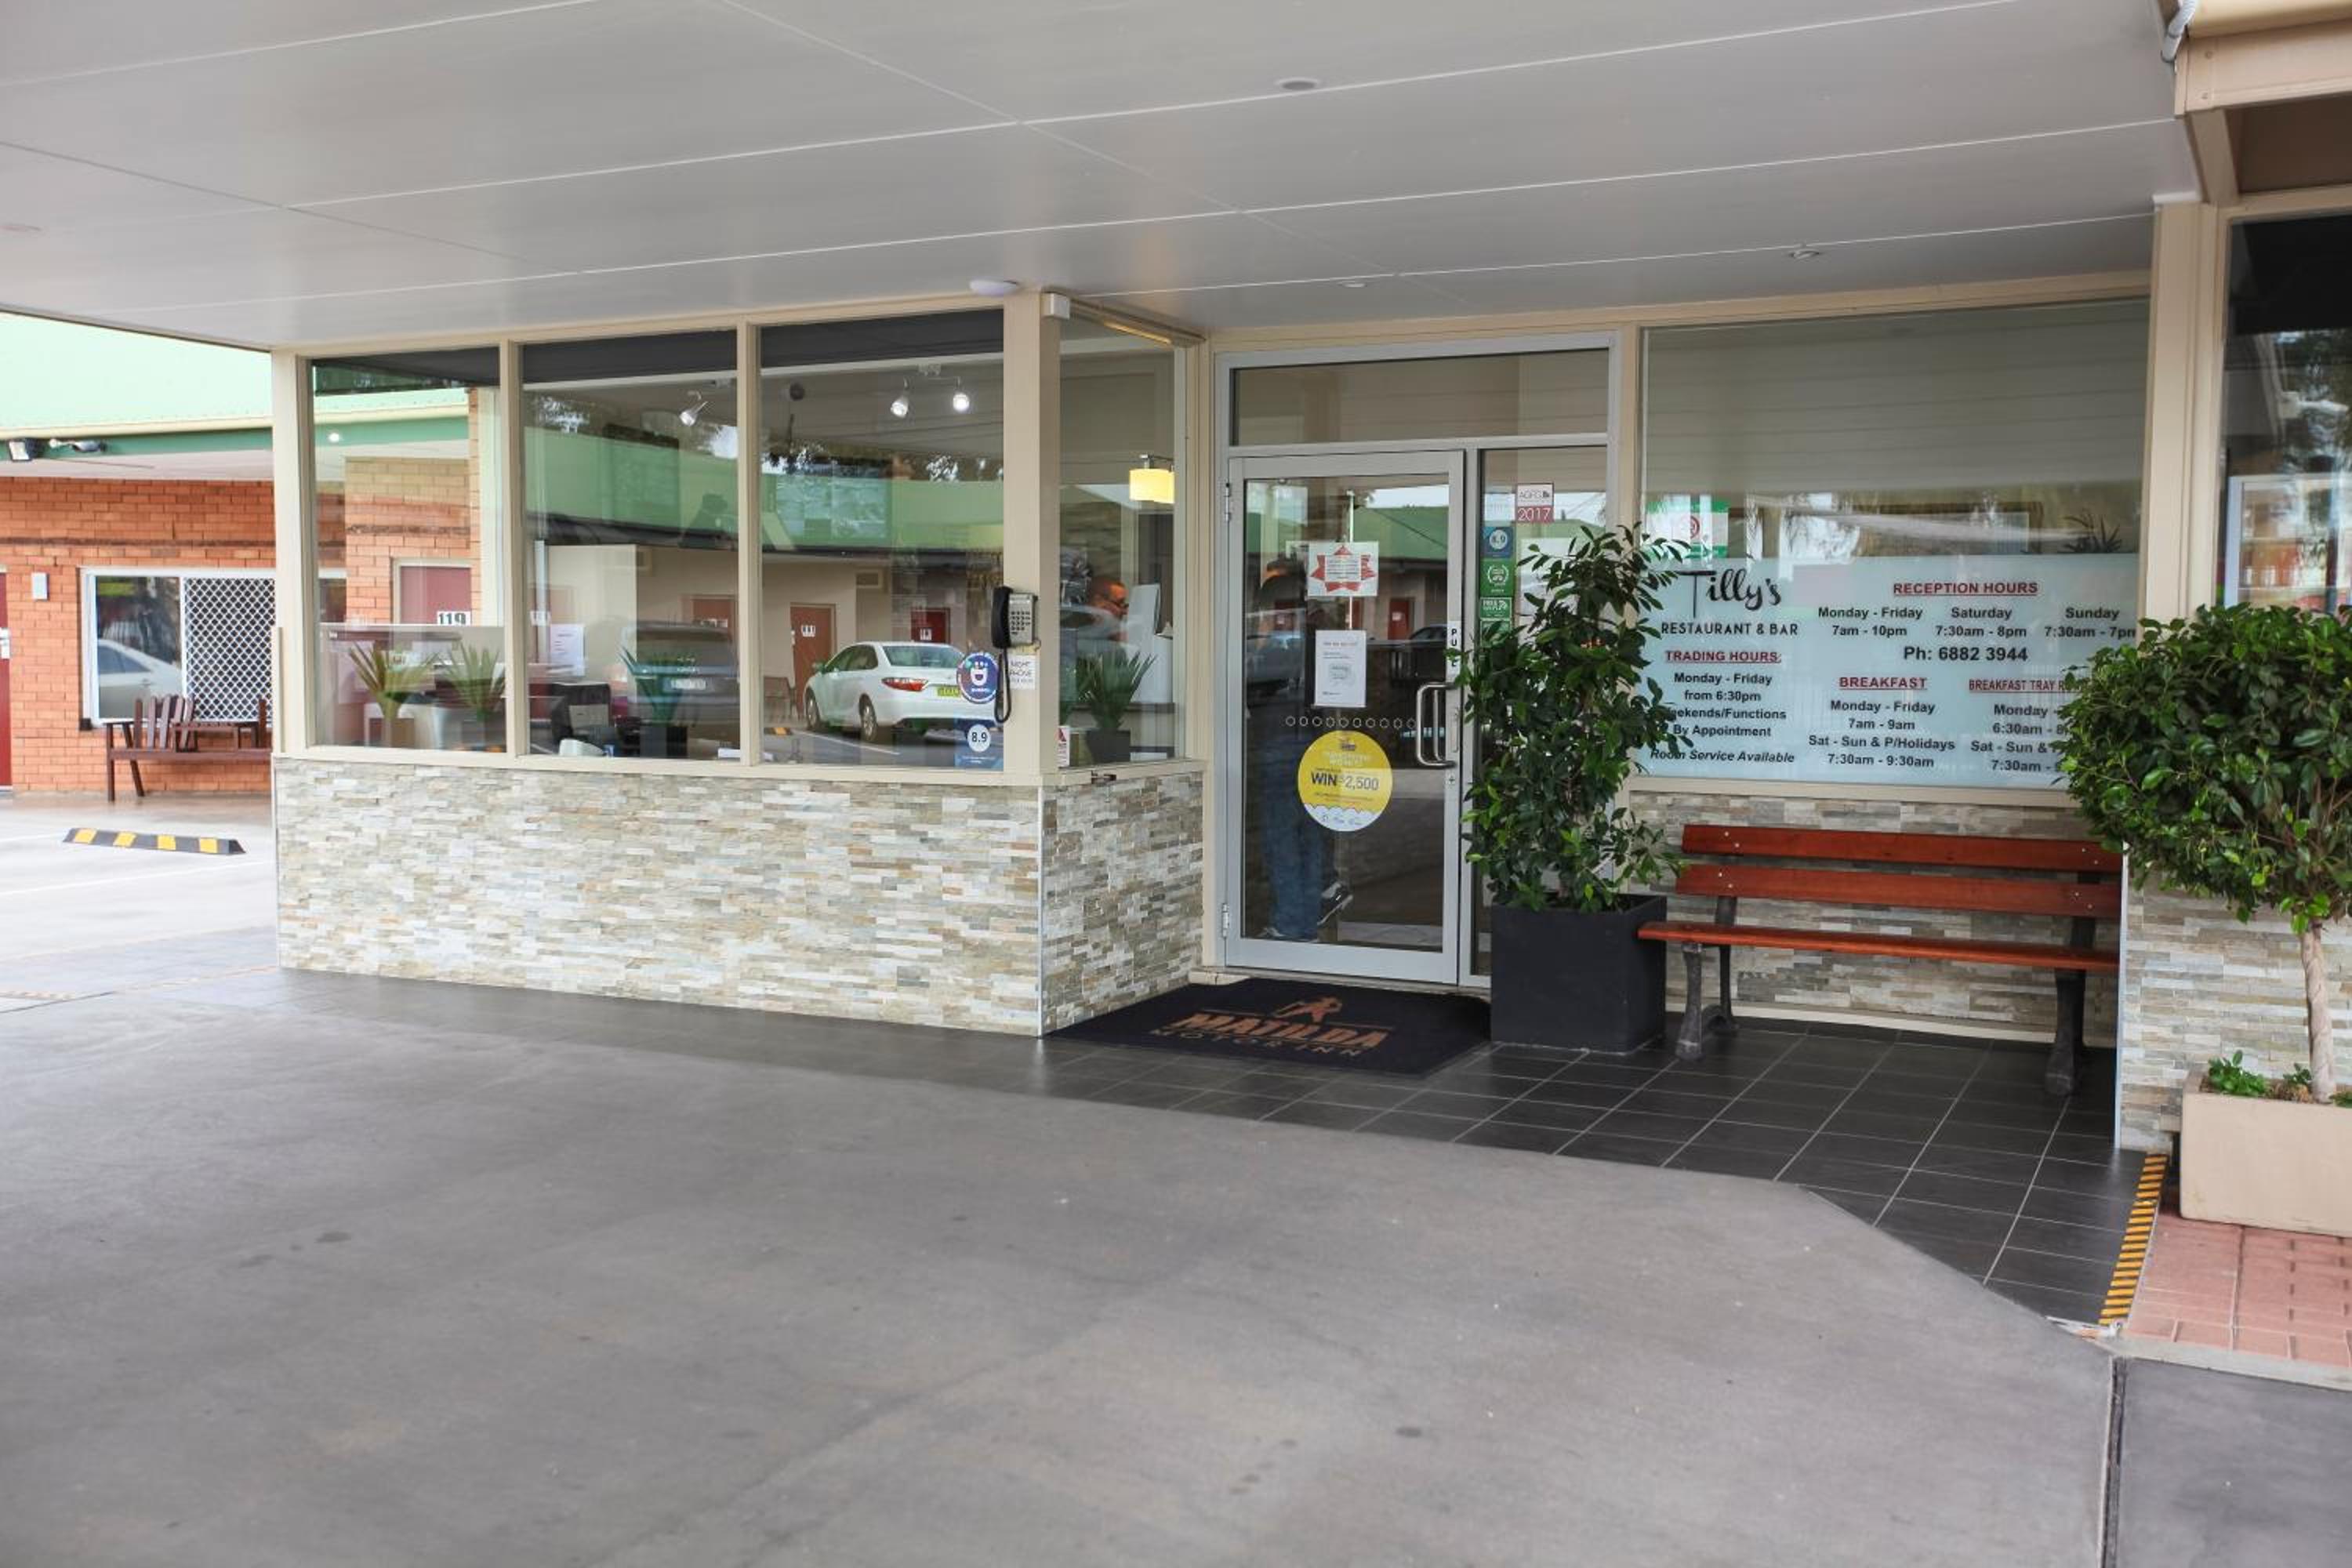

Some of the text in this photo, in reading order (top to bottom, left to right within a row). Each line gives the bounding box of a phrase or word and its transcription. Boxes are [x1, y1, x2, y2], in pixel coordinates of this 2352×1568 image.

[1518, 507, 1551, 521] 2017
[1675, 568, 1780, 618] Tilly's
[1893, 583, 2038, 593] RECEPTION HOURS
[439, 613, 466, 625] 119
[1819, 607, 1869, 619] Monday
[1882, 607, 1922, 619] Friday
[1951, 608, 2012, 620] Saturday
[2065, 608, 2120, 621] Sunday
[1661, 622, 1798, 635] RESTAURANT & BAR
[1832, 626, 1859, 636] 7am
[1872, 626, 1907, 638] 10pm
[1936, 626, 1984, 637] 7:30am
[1997, 626, 2027, 638] 8pm
[2045, 626, 2095, 637] 7:30am
[1666, 651, 1725, 662] TRADING
[1904, 646, 2028, 661] Ph: 6882 3944
[1675, 673, 1721, 685] Monday
[1733, 673, 1772, 686] Friday
[1839, 677, 1927, 688] BREAKFAST
[1969, 680, 2026, 691] BREAKFAST
[2031, 680, 2055, 691] TRAY
[1685, 690, 1761, 702] from 6:30pm
[1664, 707, 1787, 720] ekends/Functions
[1831, 700, 1881, 713] Monday
[1893, 701, 1936, 714] Friday
[1994, 704, 2048, 718] Monday
[1673, 724, 1771, 737] By Appointment
[1849, 718, 1875, 729] 7am
[1887, 719, 1915, 730] 9am
[1992, 723, 2042, 735] 6:30am
[971, 731, 987, 742] 8.9
[1809, 735, 1829, 746] Sat
[1842, 736, 1867, 747] Sun
[1871, 737, 1880, 747] &
[1884, 738, 1955, 751] P/Holidays
[1971, 740, 1994, 752] Sat
[2006, 742, 2033, 753] Sun
[2038, 742, 2047, 753] &
[1690, 750, 1734, 761] Service
[1737, 751, 1795, 763] Available
[1828, 753, 1874, 764] 7:30am
[1886, 756, 1934, 768] 9:30am
[1991, 760, 2041, 771] 7:30am
[1311, 771, 1337, 786] WIN
[1168, 1014, 1388, 1047] MATILDA
